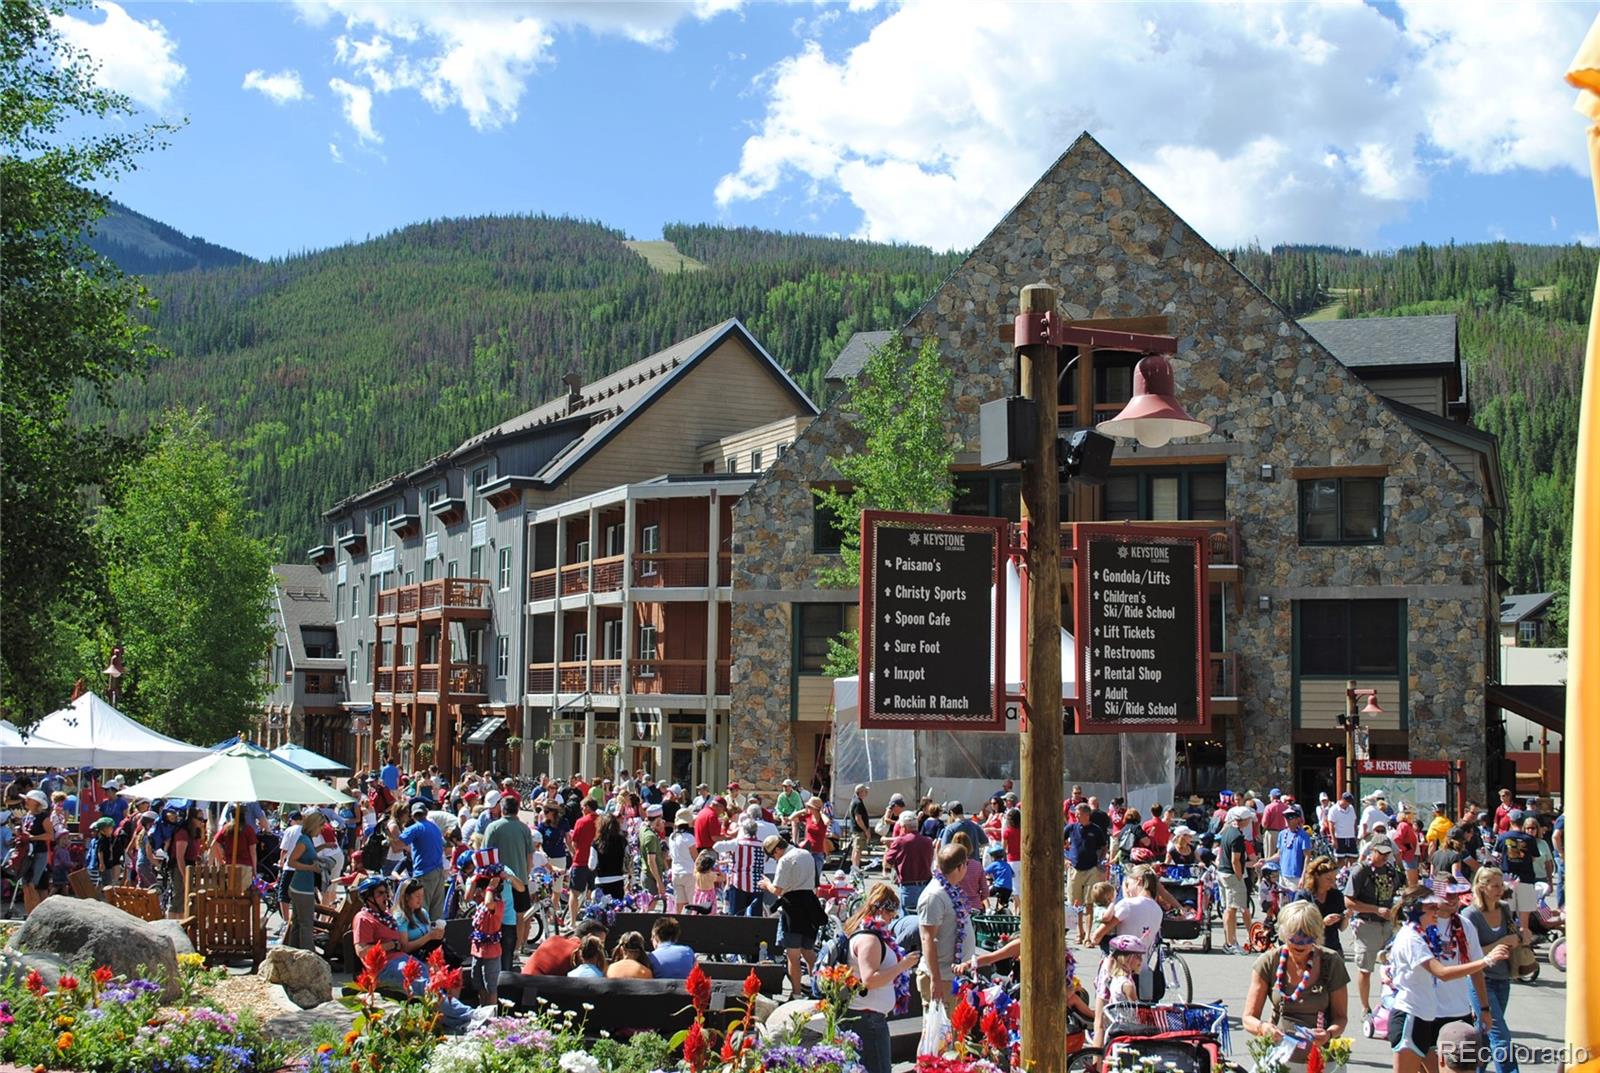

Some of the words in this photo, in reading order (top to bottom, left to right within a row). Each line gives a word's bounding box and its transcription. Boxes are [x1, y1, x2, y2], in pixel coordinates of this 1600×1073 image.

[923, 532, 965, 547] KEYSTONE
[1131, 546, 1169, 560] KEYSTONE
[896, 557, 941, 572] Paisano's
[1103, 568, 1170, 585] Gondola/Lifts
[896, 585, 930, 601] Christy
[934, 586, 966, 602] Sports
[1103, 590, 1146, 604] Children's
[895, 611, 925, 626] Spoon
[929, 612, 950, 626] Cafe
[1103, 604, 1143, 619] Ski/Ride
[1146, 606, 1175, 619] School
[1103, 625, 1120, 638] Lift
[1123, 626, 1155, 639] Tickets
[895, 640, 916, 653] Sure
[919, 640, 940, 653] Foot
[1104, 645, 1155, 659] Restrooms
[894, 666, 925, 681] Inxpot
[1104, 666, 1135, 680] Rental
[1139, 666, 1162, 682] Shop
[1105, 687, 1128, 700] Adult
[894, 695, 926, 708] Rockin
[929, 696, 937, 708] R
[940, 696, 968, 709] Ranch
[1105, 701, 1144, 715] Ski/Ride
[1147, 702, 1176, 716] School
[1376, 761, 1412, 771] KEYSTONE
